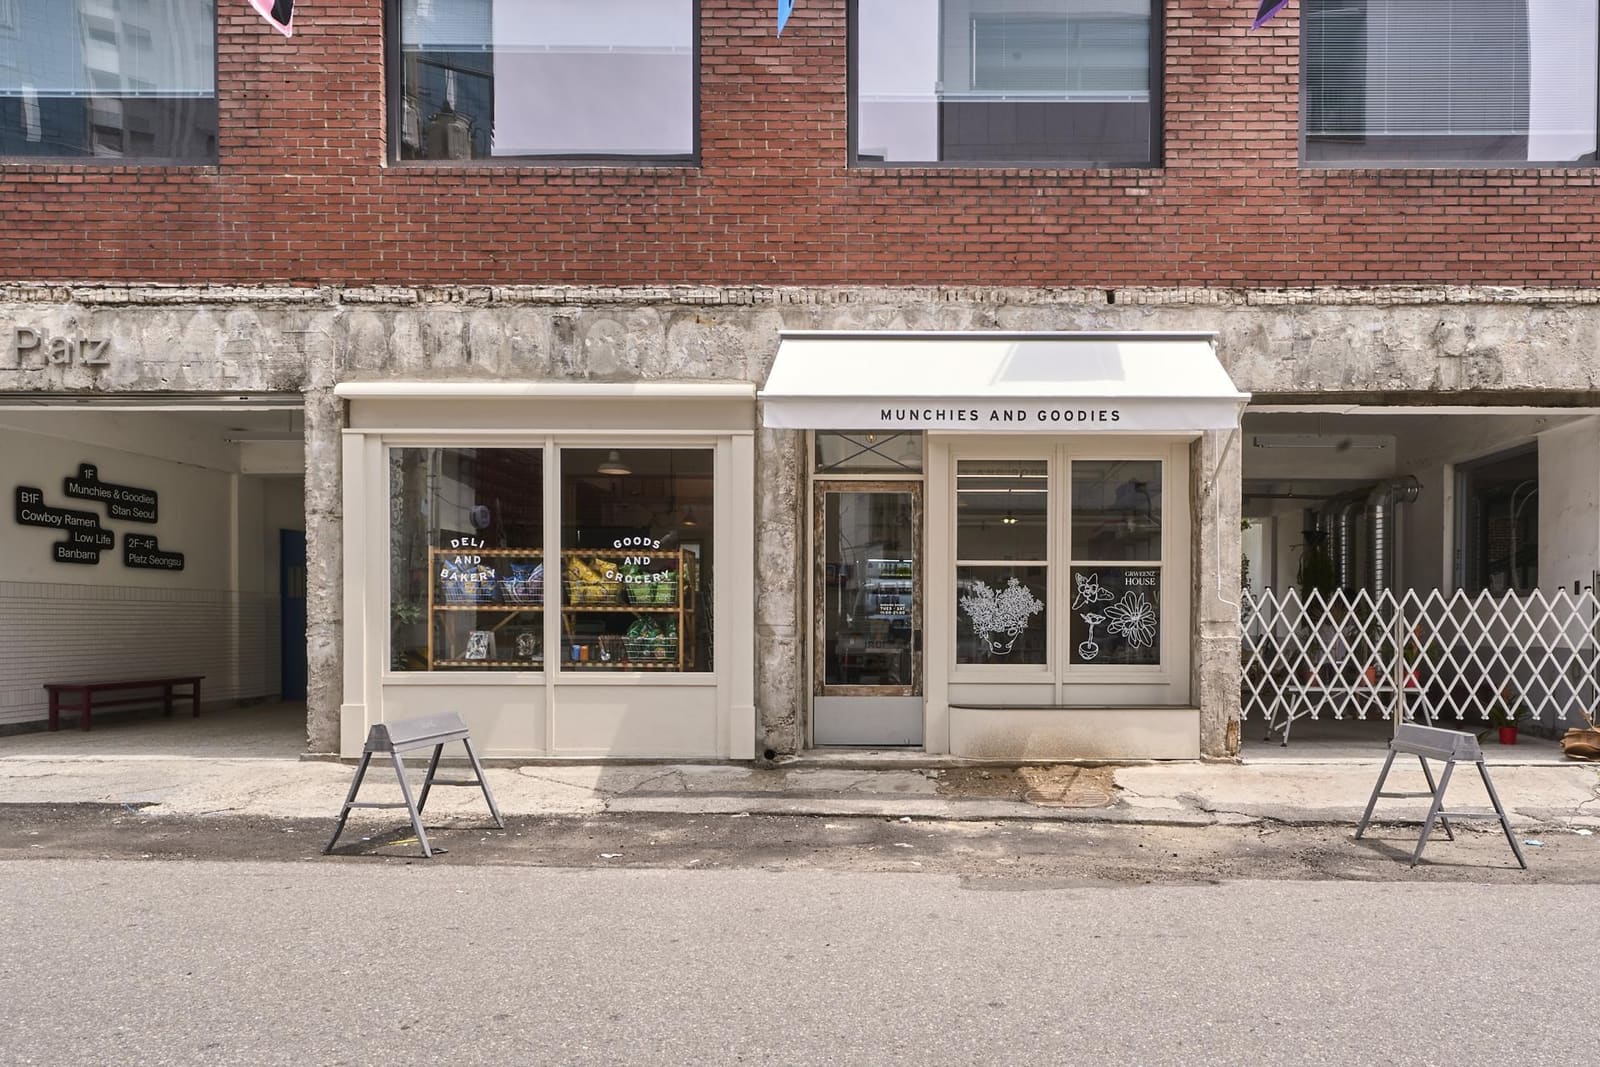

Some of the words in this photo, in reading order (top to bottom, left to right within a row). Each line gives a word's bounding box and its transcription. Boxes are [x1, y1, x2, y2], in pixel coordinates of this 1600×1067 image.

[14, 327, 111, 365] Platz
[881, 409, 979, 421] MUNCHIES
[990, 409, 1027, 421] AND
[1037, 410, 1120, 422] GOODIES
[84, 469, 94, 479] 1F
[21, 492, 39, 504] B1F
[69, 482, 112, 498] Munchies
[113, 489, 120, 499] &
[122, 491, 155, 504] Goodies
[21, 509, 62, 526] Cowboy
[64, 514, 96, 528] Ramen
[112, 506, 132, 516] Stan
[133, 508, 155, 519] Seoul
[74, 532, 94, 543] Low
[96, 534, 111, 545] Life
[128, 538, 155, 549] 2F-4F
[450, 537, 485, 549] DELI
[613, 536, 661, 549] GOODS
[128, 553, 147, 564] Platz
[149, 555, 182, 568] Seongsu
[455, 555, 481, 565] AND
[624, 556, 651, 565] AND
[440, 568, 496, 582] BAKERY
[605, 569, 669, 584] GROCERY
[1125, 577, 1156, 586] HOUSE
